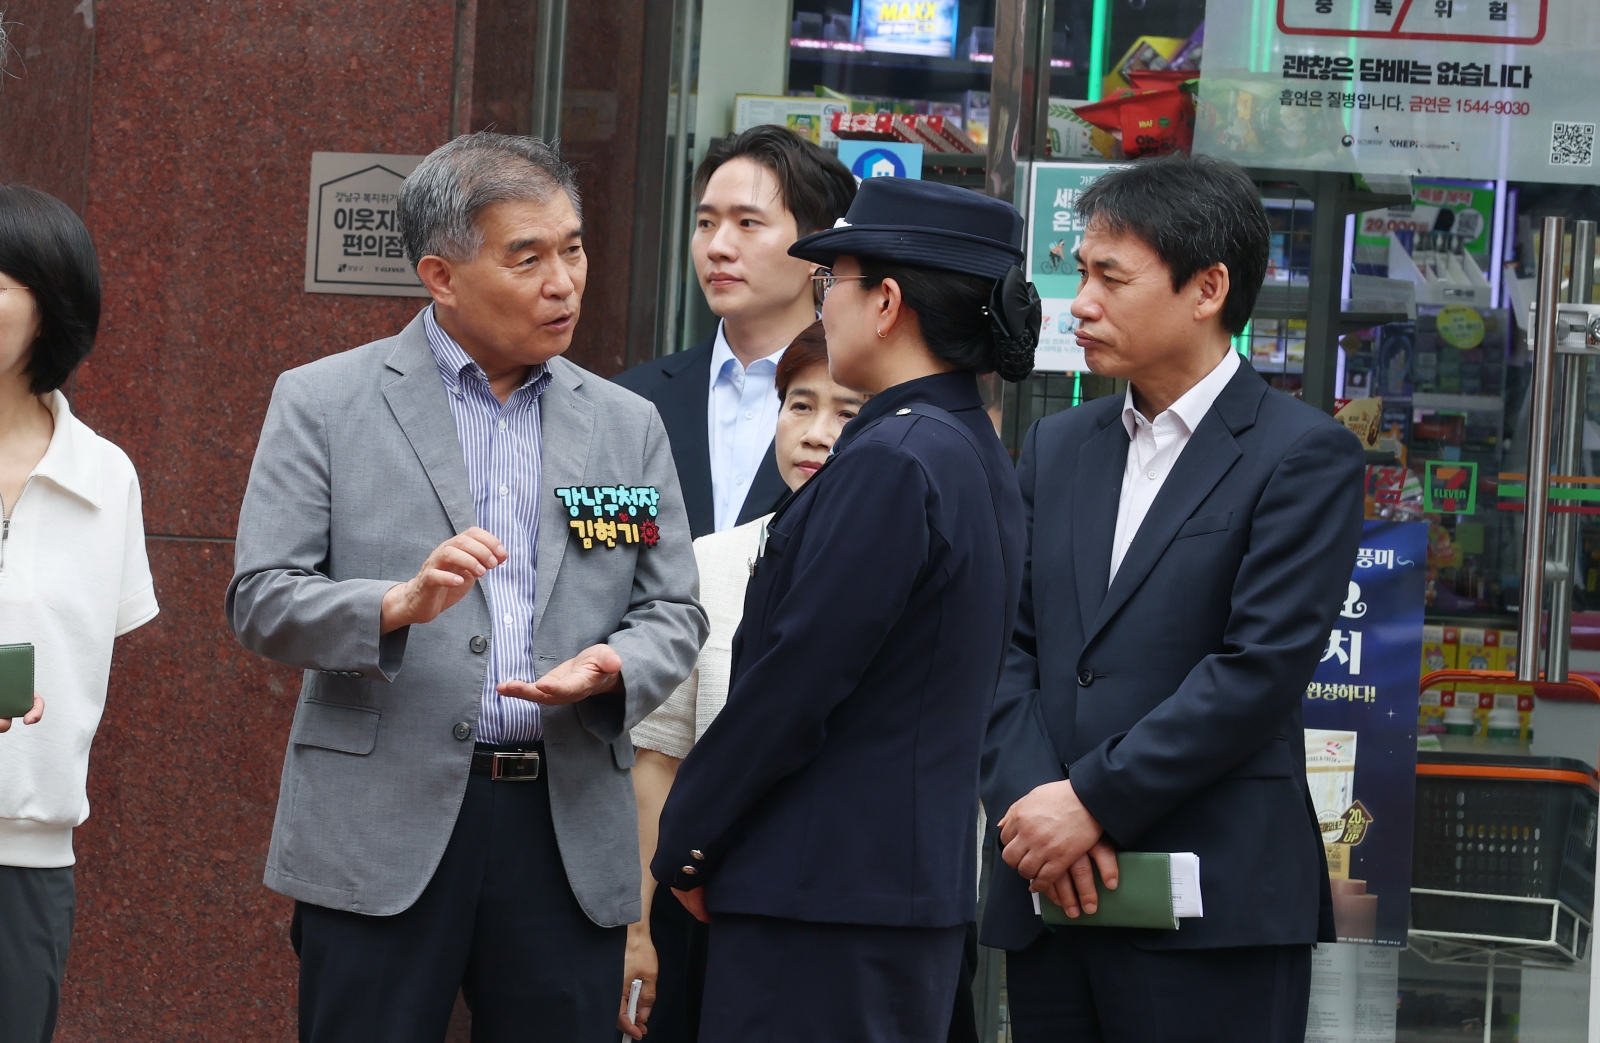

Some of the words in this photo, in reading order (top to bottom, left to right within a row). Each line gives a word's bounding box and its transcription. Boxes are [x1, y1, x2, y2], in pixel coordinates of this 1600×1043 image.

[879, 2, 936, 21] MAXX
[1489, 1, 1508, 21] 험
[1282, 55, 1354, 81] 괜찮은
[1359, 58, 1432, 84] 담배는
[1437, 61, 1532, 89] 없습니다
[1279, 89, 1323, 107] 흡연은
[1326, 91, 1404, 111] 질병입니다.
[1409, 95, 1451, 113] 금연은
[1456, 99, 1530, 116] 1544-9030
[335, 191, 360, 203] 강남구
[334, 208, 400, 232] 이웃지
[342, 234, 404, 258] 편의점
[555, 485, 660, 517] 강남구청장
[569, 517, 640, 549] 김현기
[1343, 833, 1359, 842] UP
